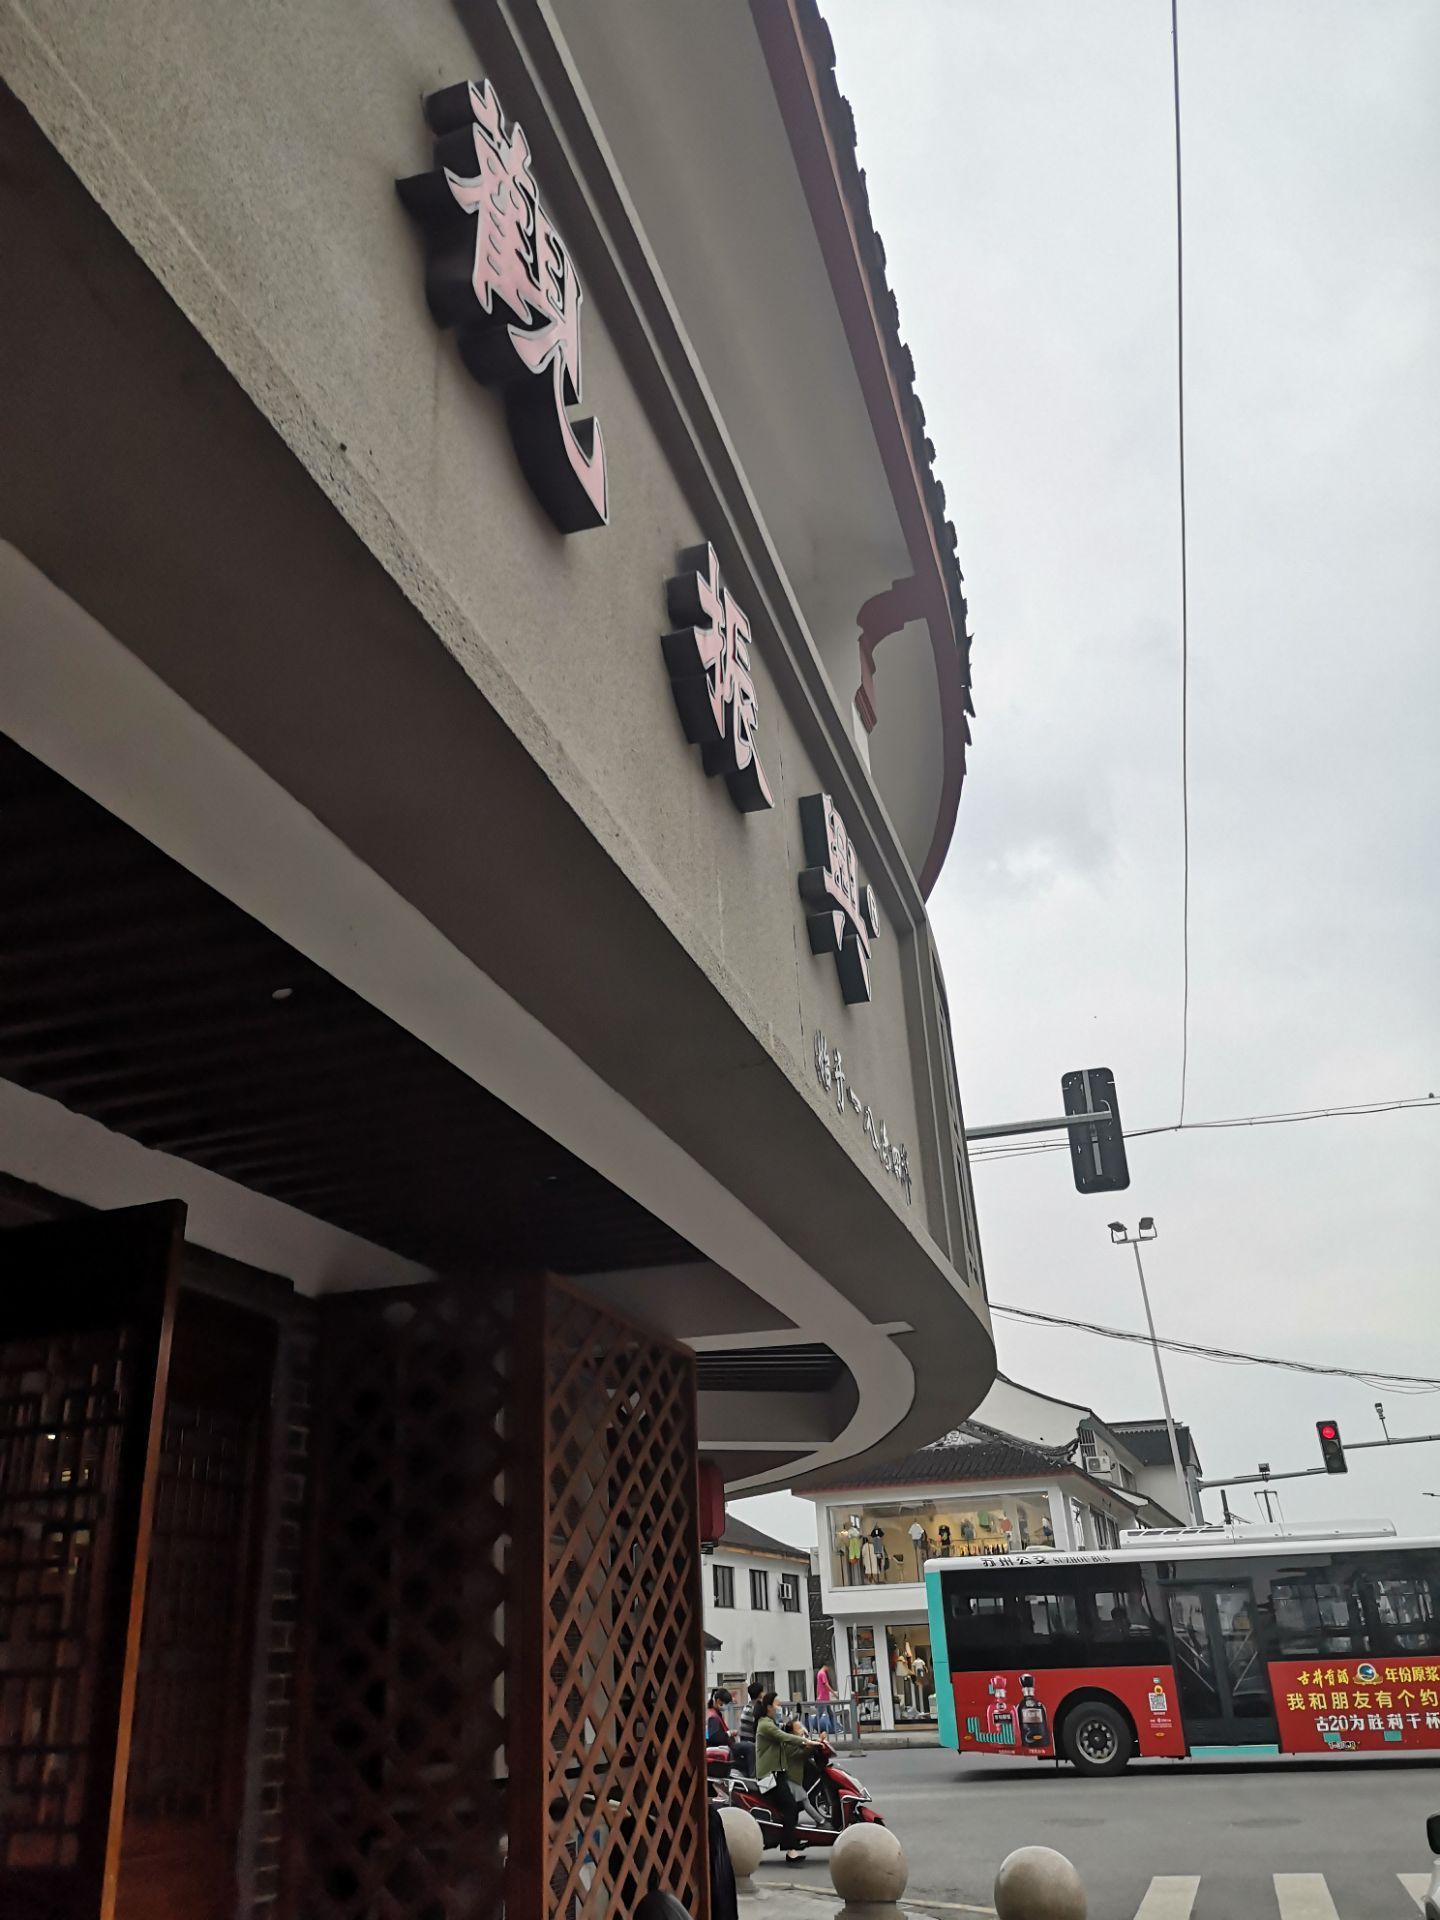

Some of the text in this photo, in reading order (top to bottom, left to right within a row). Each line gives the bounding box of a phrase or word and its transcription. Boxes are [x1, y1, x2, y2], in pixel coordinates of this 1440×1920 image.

[982, 1556, 1049, 1567] 苏州公交
[1052, 1556, 1088, 1564] SUZHOU
[1286, 1688, 1438, 1711] 我和朋友有个约
